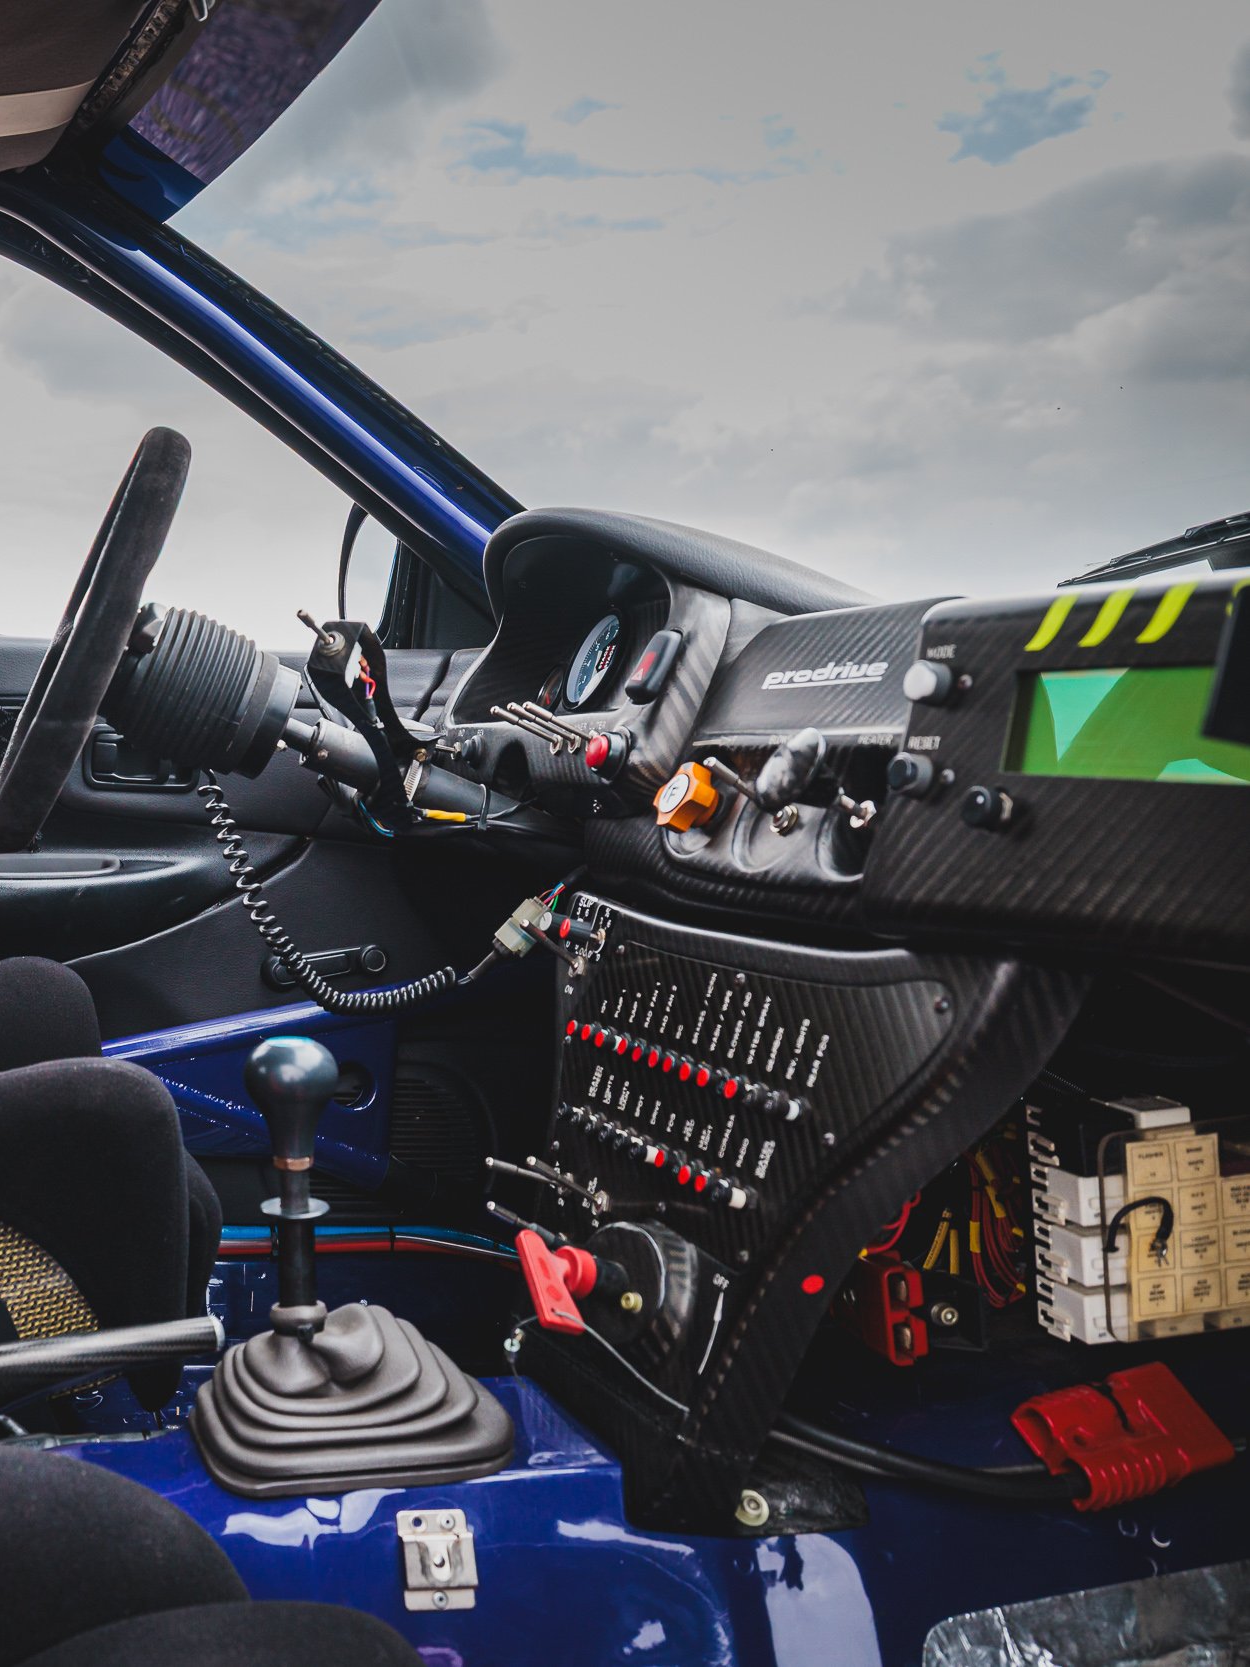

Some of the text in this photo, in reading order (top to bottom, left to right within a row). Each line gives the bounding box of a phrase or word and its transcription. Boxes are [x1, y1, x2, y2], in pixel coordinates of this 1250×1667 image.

[761, 661, 889, 690] prodrive
[857, 734, 894, 746] HEATER
[907, 735, 942, 750] RESET
[578, 896, 594, 907] SLIP
[614, 996, 623, 1018] PUMP
[629, 1001, 638, 1023] PUMP
[644, 1010, 653, 1028] RAD
[650, 989, 659, 1008] FAN
[659, 1015, 669, 1034] RAD
[665, 994, 675, 1012] FAN
[691, 1010, 707, 1045] BRAKES
[706, 972, 718, 998] HORN
[710, 1024, 722, 1051] WASH
[721, 990, 733, 1011] WIPE
[727, 1020, 744, 1059] BLOWER
[743, 991, 752, 1007] IND
[746, 995, 772, 1065] WATER SPRAY
[765, 1026, 785, 1072] GEARBOX
[785, 1018, 811, 1080] REV. LIGHTS
[806, 1034, 830, 1088] REAR FOG
[602, 1074, 615, 1103] LIGHTS
[617, 1080, 630, 1110] LIGHTS
[634, 1094, 644, 1118] SPOT
[650, 1100, 661, 1125] DRIVE
[666, 1113, 676, 1132] FOG
[717, 1114, 736, 1159] CORALBA
[735, 1137, 749, 1168] RADIO
